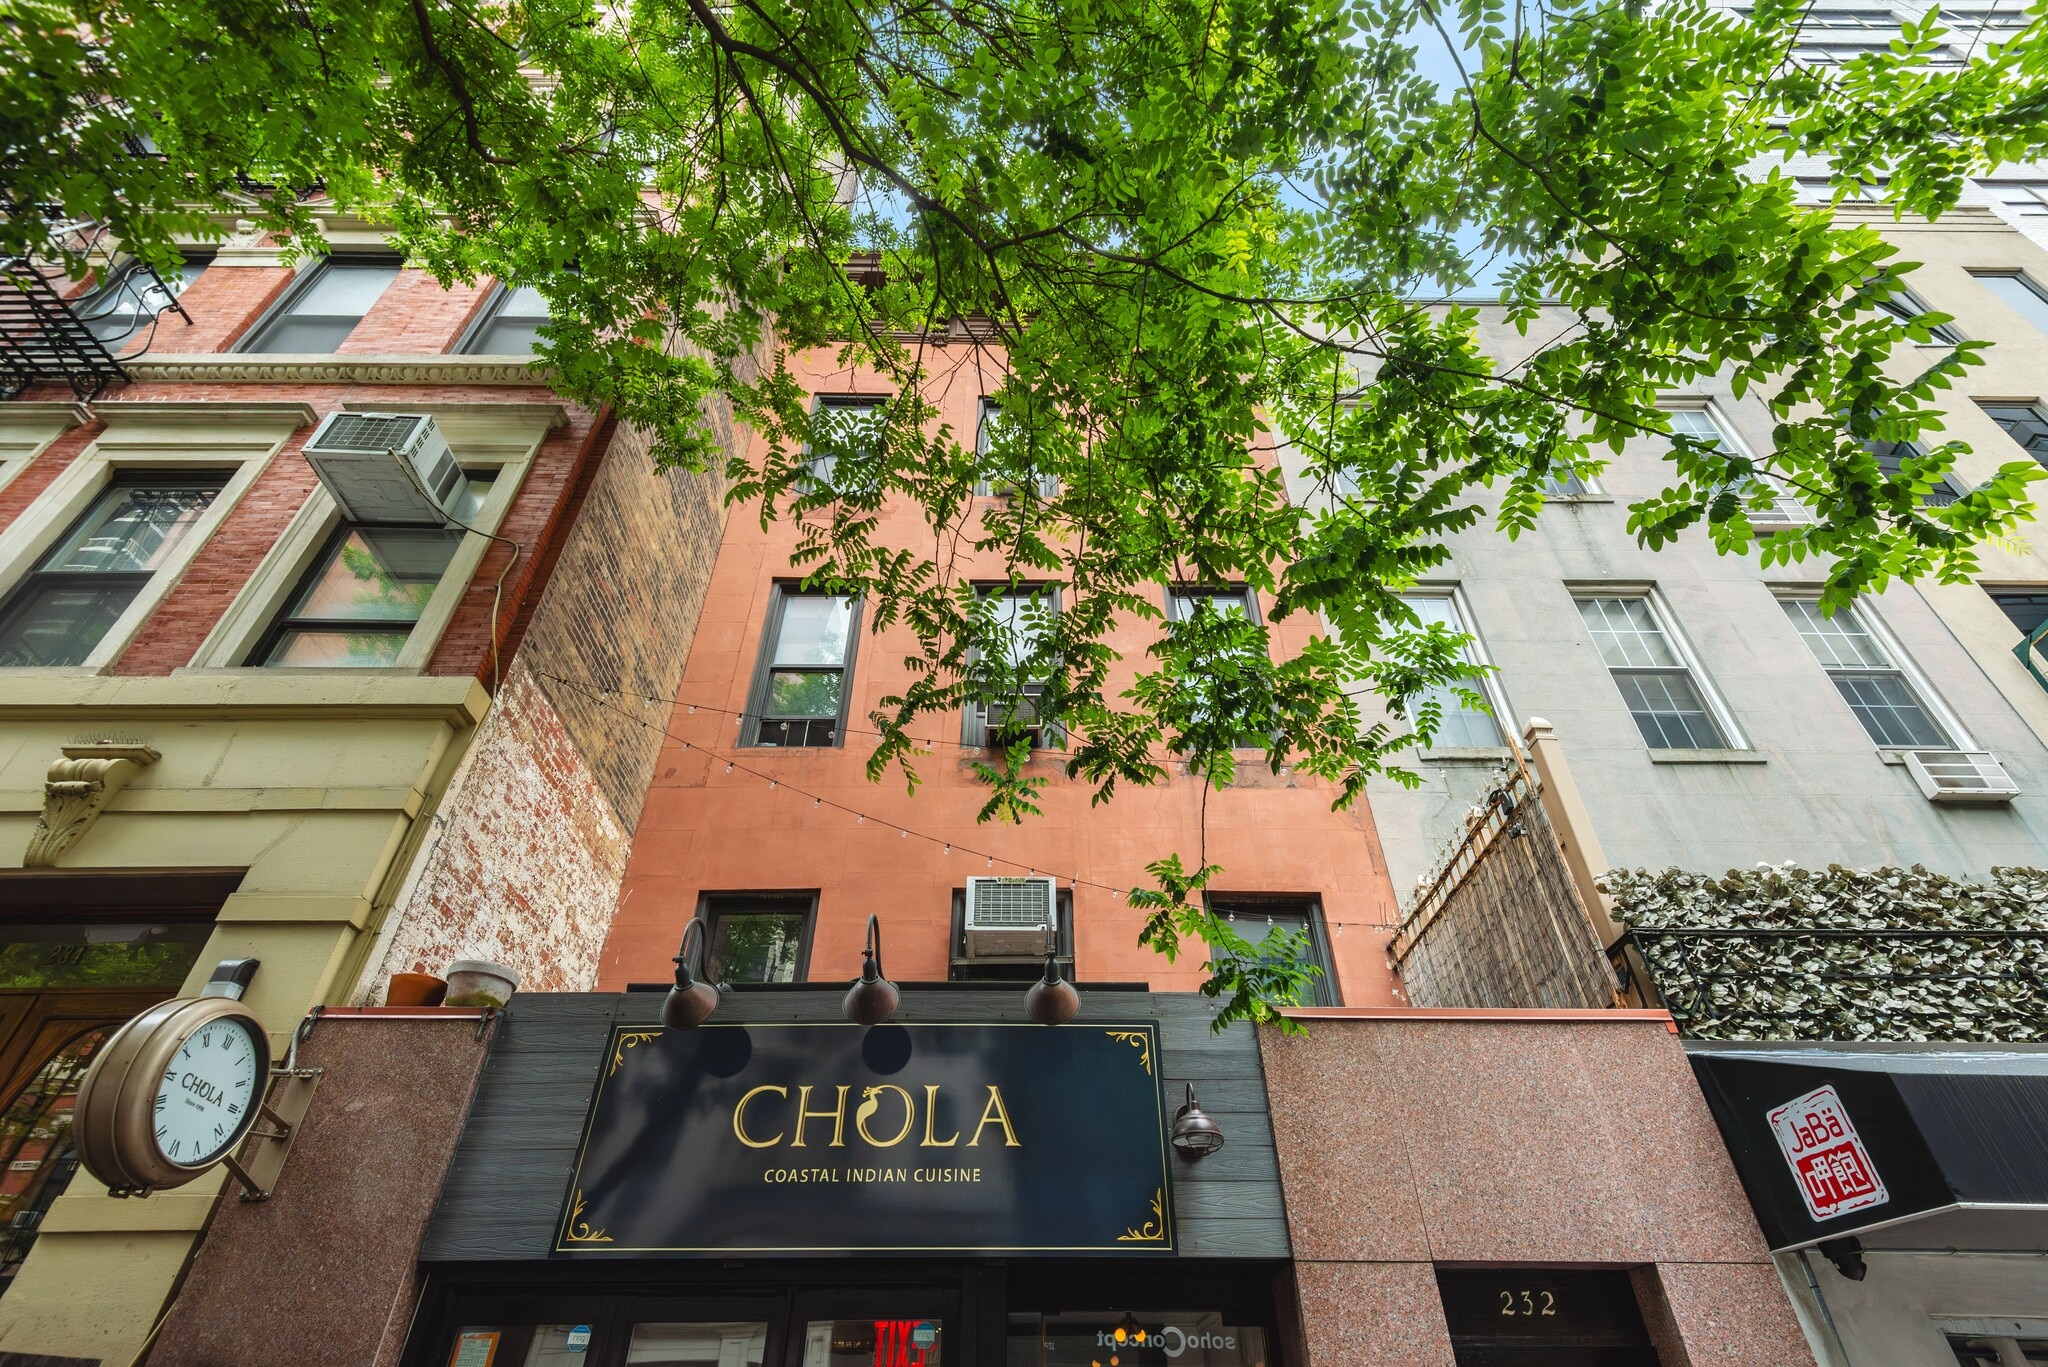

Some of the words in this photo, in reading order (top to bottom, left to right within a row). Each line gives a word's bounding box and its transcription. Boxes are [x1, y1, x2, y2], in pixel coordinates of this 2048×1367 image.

[182, 1072, 225, 1107] CHOLA
[733, 1084, 1022, 1148] CHOLA
[1790, 1107, 1845, 1153] JaBä
[764, 1168, 840, 1183] COASTAL
[846, 1168, 907, 1182] INDIAN
[913, 1168, 981, 1182] CUISINE
[1500, 1290, 1556, 1316] 232
